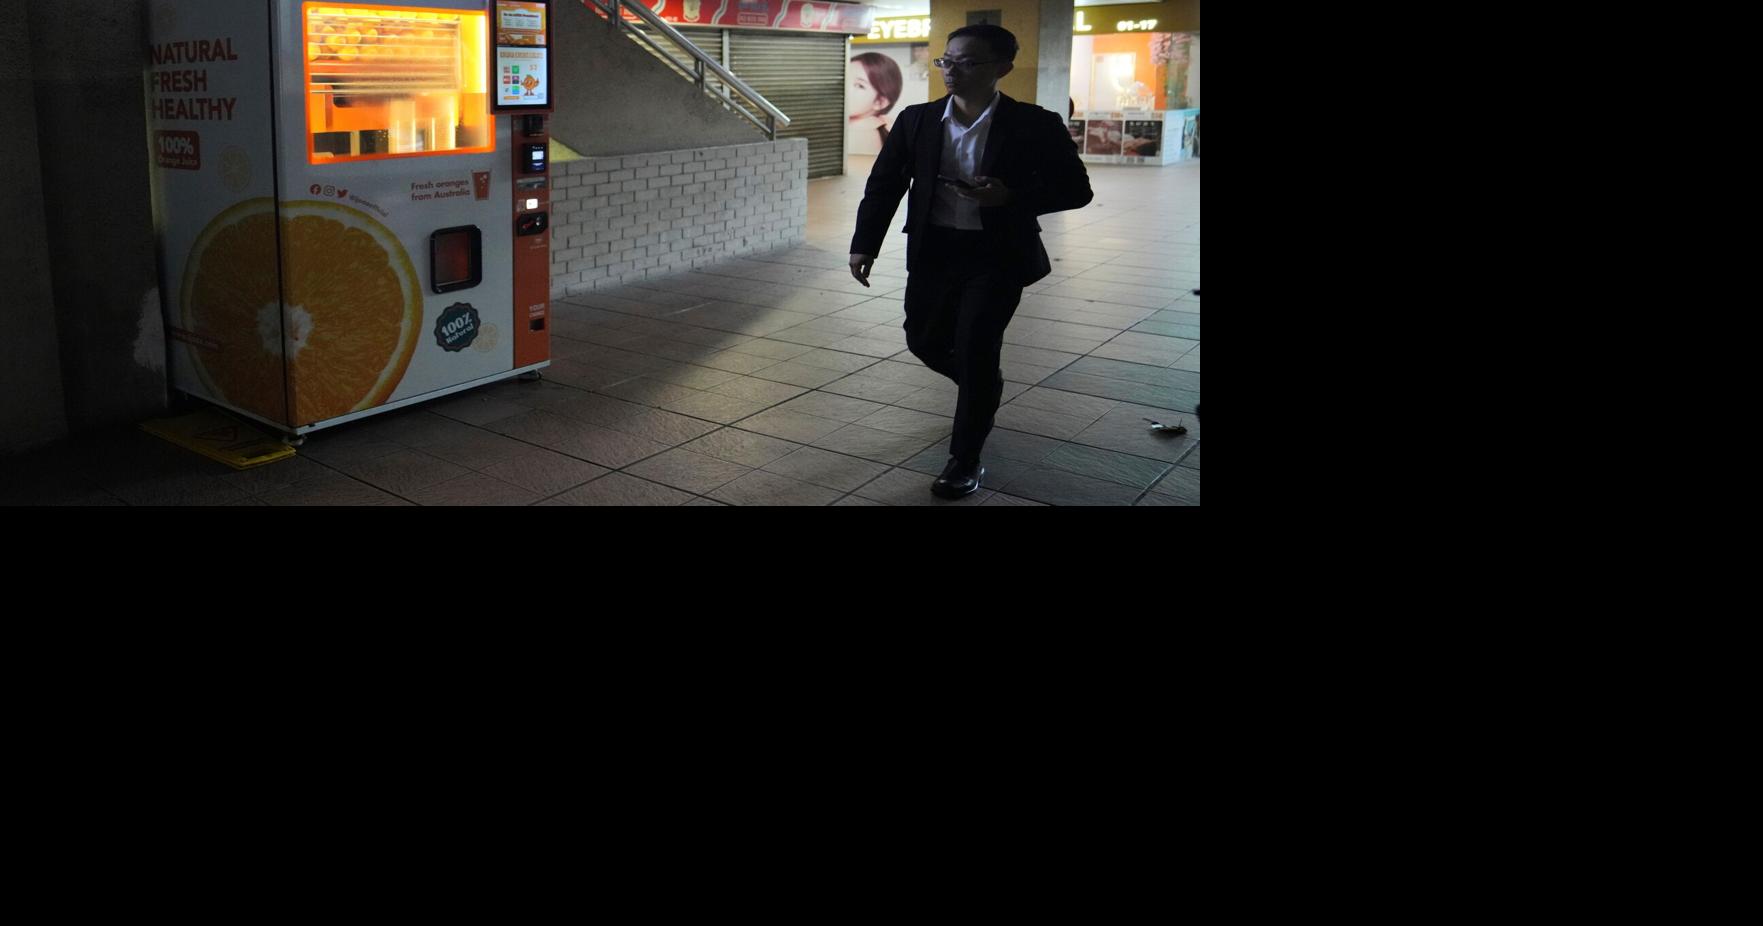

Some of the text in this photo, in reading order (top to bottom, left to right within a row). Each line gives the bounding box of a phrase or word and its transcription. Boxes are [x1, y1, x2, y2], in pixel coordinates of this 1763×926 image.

[149, 37, 238, 65] NATURAL
[150, 69, 208, 93] FRESH
[151, 96, 237, 121] HEALTHY
[158, 135, 194, 155] 100%
[411, 179, 470, 190] Fresh oranges
[411, 188, 471, 201] from Australia
[441, 311, 473, 336] 100%
